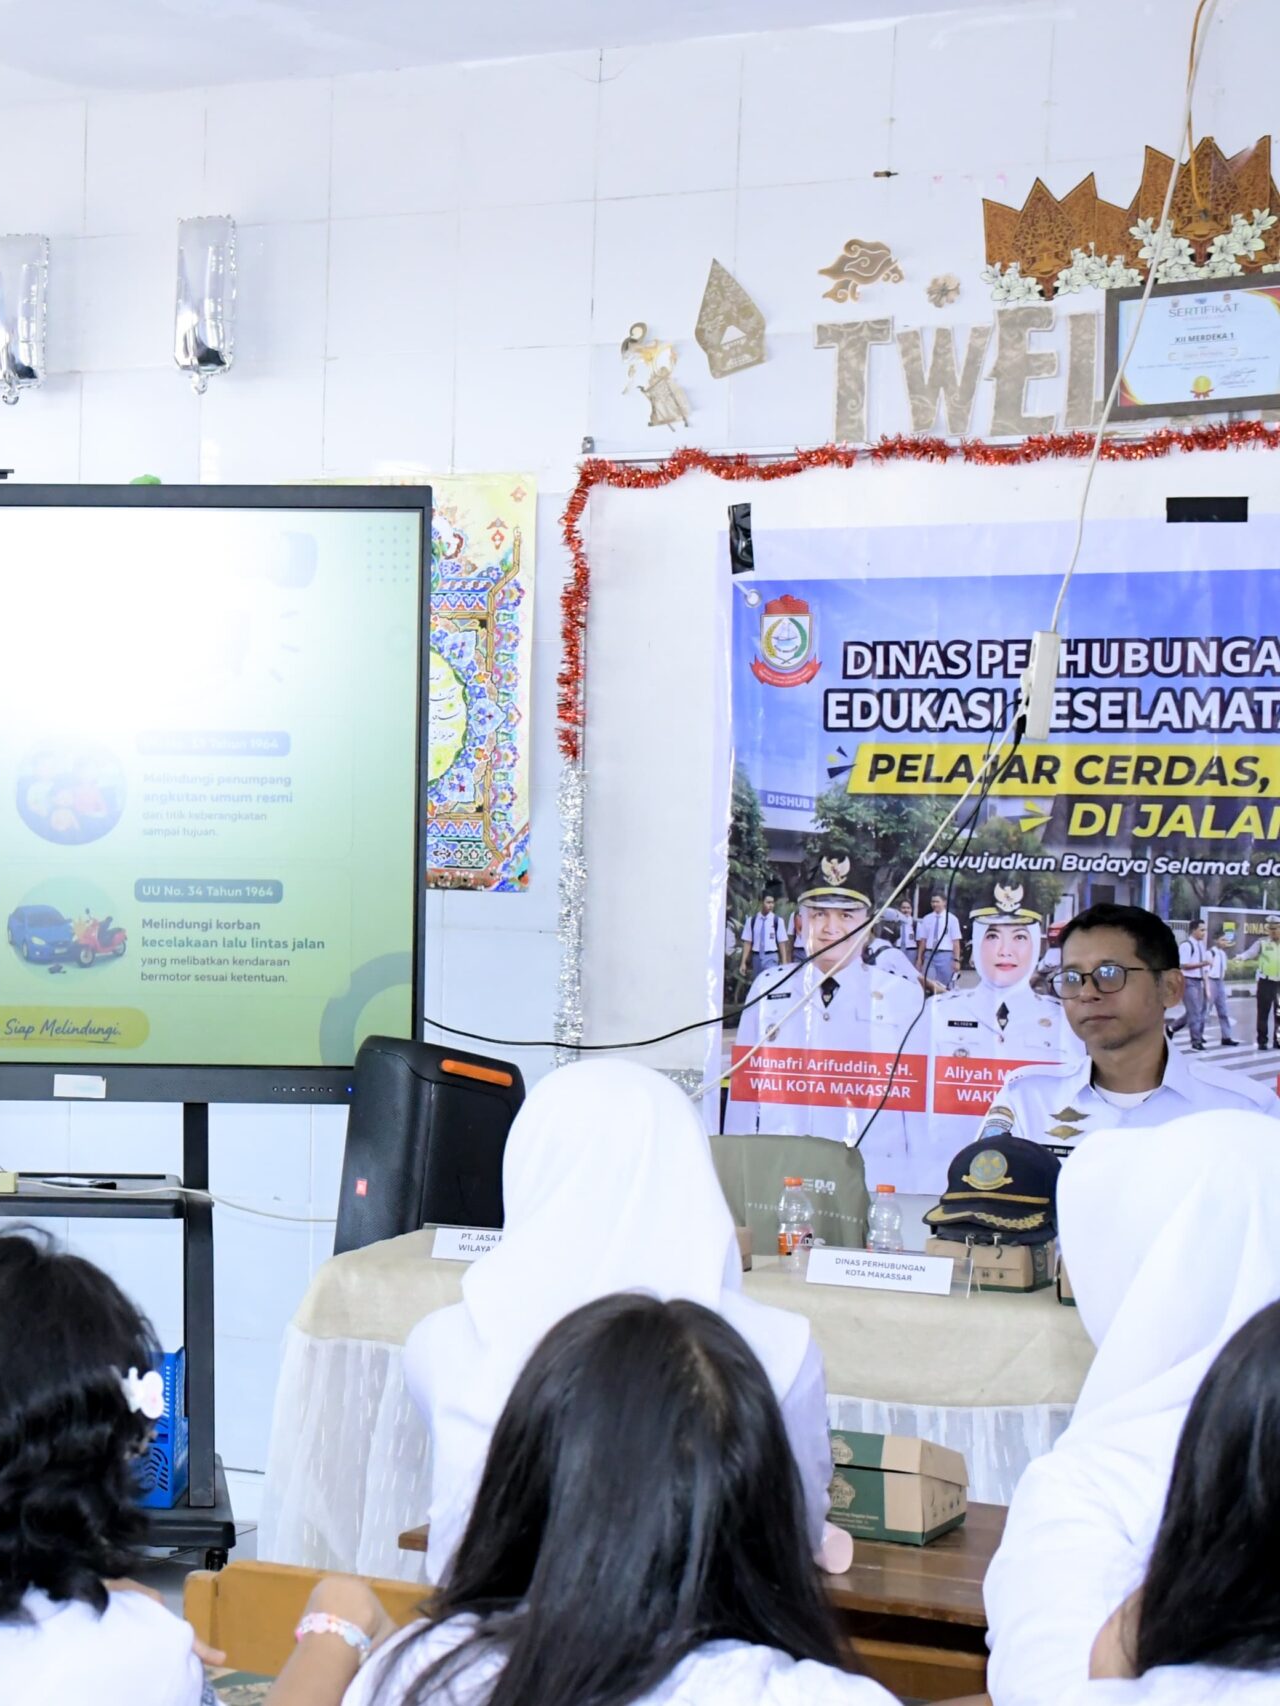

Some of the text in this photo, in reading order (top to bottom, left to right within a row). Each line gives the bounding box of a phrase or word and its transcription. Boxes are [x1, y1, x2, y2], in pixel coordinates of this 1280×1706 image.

[1168, 303, 1239, 318] SERTIFIKAT
[1188, 333, 1228, 343] MERDEKA
[815, 306, 1103, 442] TWEL
[845, 642, 969, 677] DINAS
[980, 640, 1280, 677] PEHUBUNGA
[826, 690, 1280, 731] EDUKASI ESELAMAT
[867, 752, 1270, 793] PELAJAR CERDAS,
[217, 775, 293, 788] penumpang
[211, 793, 252, 803] umum
[256, 792, 293, 804] resmi
[767, 794, 810, 809] DISHUB
[1067, 802, 1123, 839] DI
[142, 827, 179, 839] sampai
[1062, 855, 1148, 877] Budaya
[1152, 856, 1250, 876] Selamat
[142, 886, 274, 898] UU No. 34 Tahun 1964
[141, 919, 261, 933] Melindungi korban
[141, 937, 325, 953] kecelakaan lalu lintas jalan
[141, 956, 290, 968] yang melibatkan kendaraan
[141, 972, 288, 984] bermotor sesuai ketentuan.
[4, 1018, 36, 1040] Siap
[806, 1058, 882, 1077] Arifuddin,
[885, 1062, 913, 1077] S.H.
[943, 1066, 993, 1083] Aliyah
[750, 1077, 912, 1100] WALI KOTA MAKASSAR
[460, 1233, 474, 1241] PT.
[476, 1234, 496, 1242] JASA
[835, 1257, 926, 1273] DINAS PERHUBUNGAN
[845, 1269, 913, 1282] KOTA MAKASSAR
